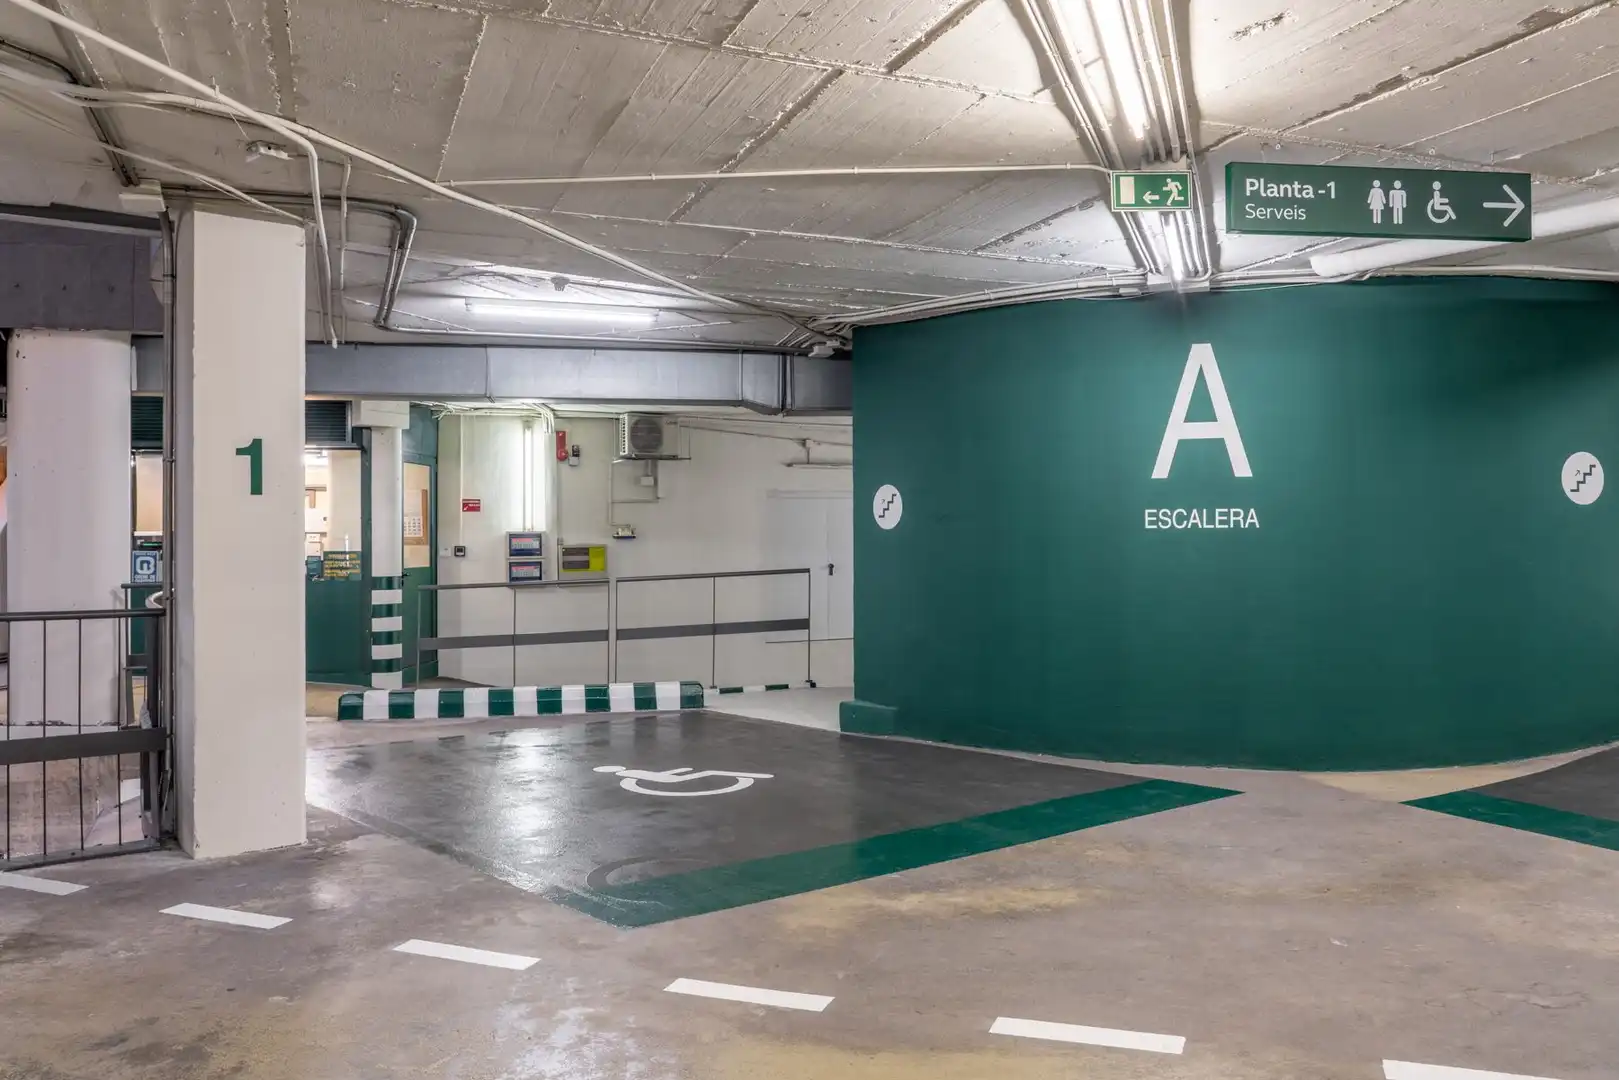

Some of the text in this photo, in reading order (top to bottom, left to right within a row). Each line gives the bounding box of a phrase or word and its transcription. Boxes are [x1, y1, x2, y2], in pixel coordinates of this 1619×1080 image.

[1245, 178, 1336, 199] Planta -1
[1245, 203, 1307, 221] Serveis
[1150, 342, 1253, 479] A
[235, 438, 263, 496] 1
[1144, 508, 1260, 530] ESCALERA
